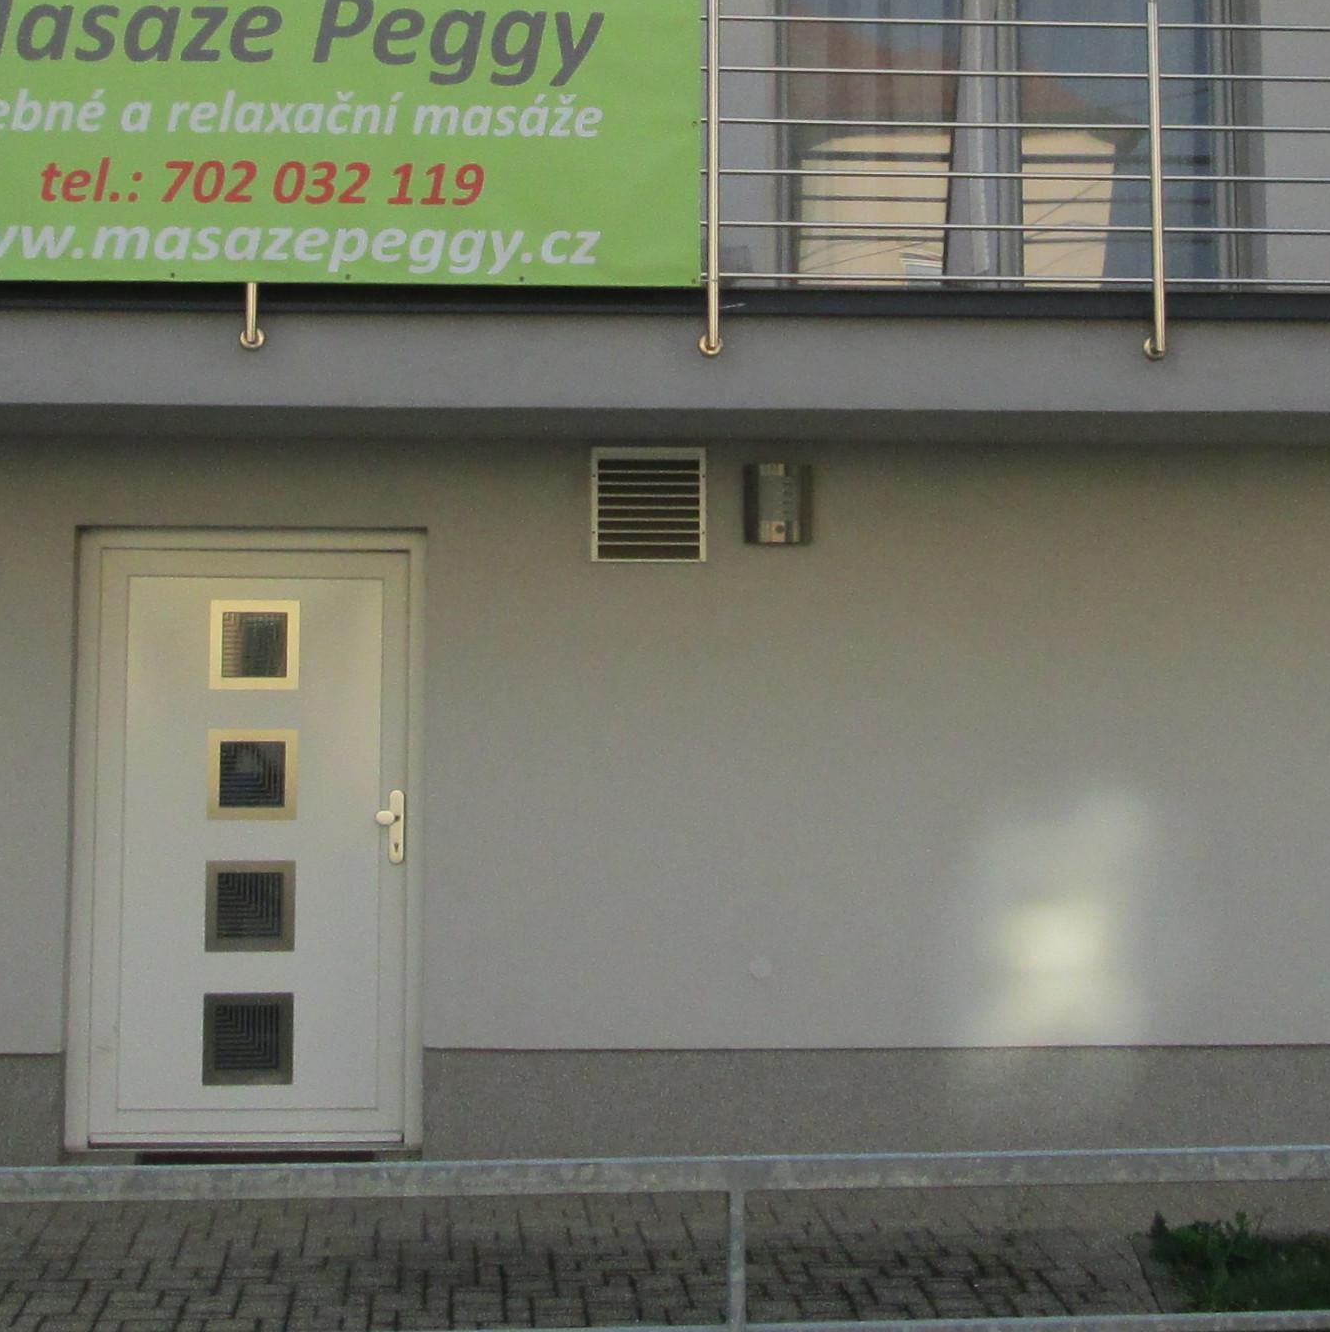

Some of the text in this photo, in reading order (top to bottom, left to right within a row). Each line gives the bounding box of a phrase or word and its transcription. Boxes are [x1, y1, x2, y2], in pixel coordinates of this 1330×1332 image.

[120, 102, 149, 134] a
[167, 90, 403, 136] relaxační
[412, 94, 604, 139] masáže
[40, 157, 485, 207] tel.: 702 032 119
